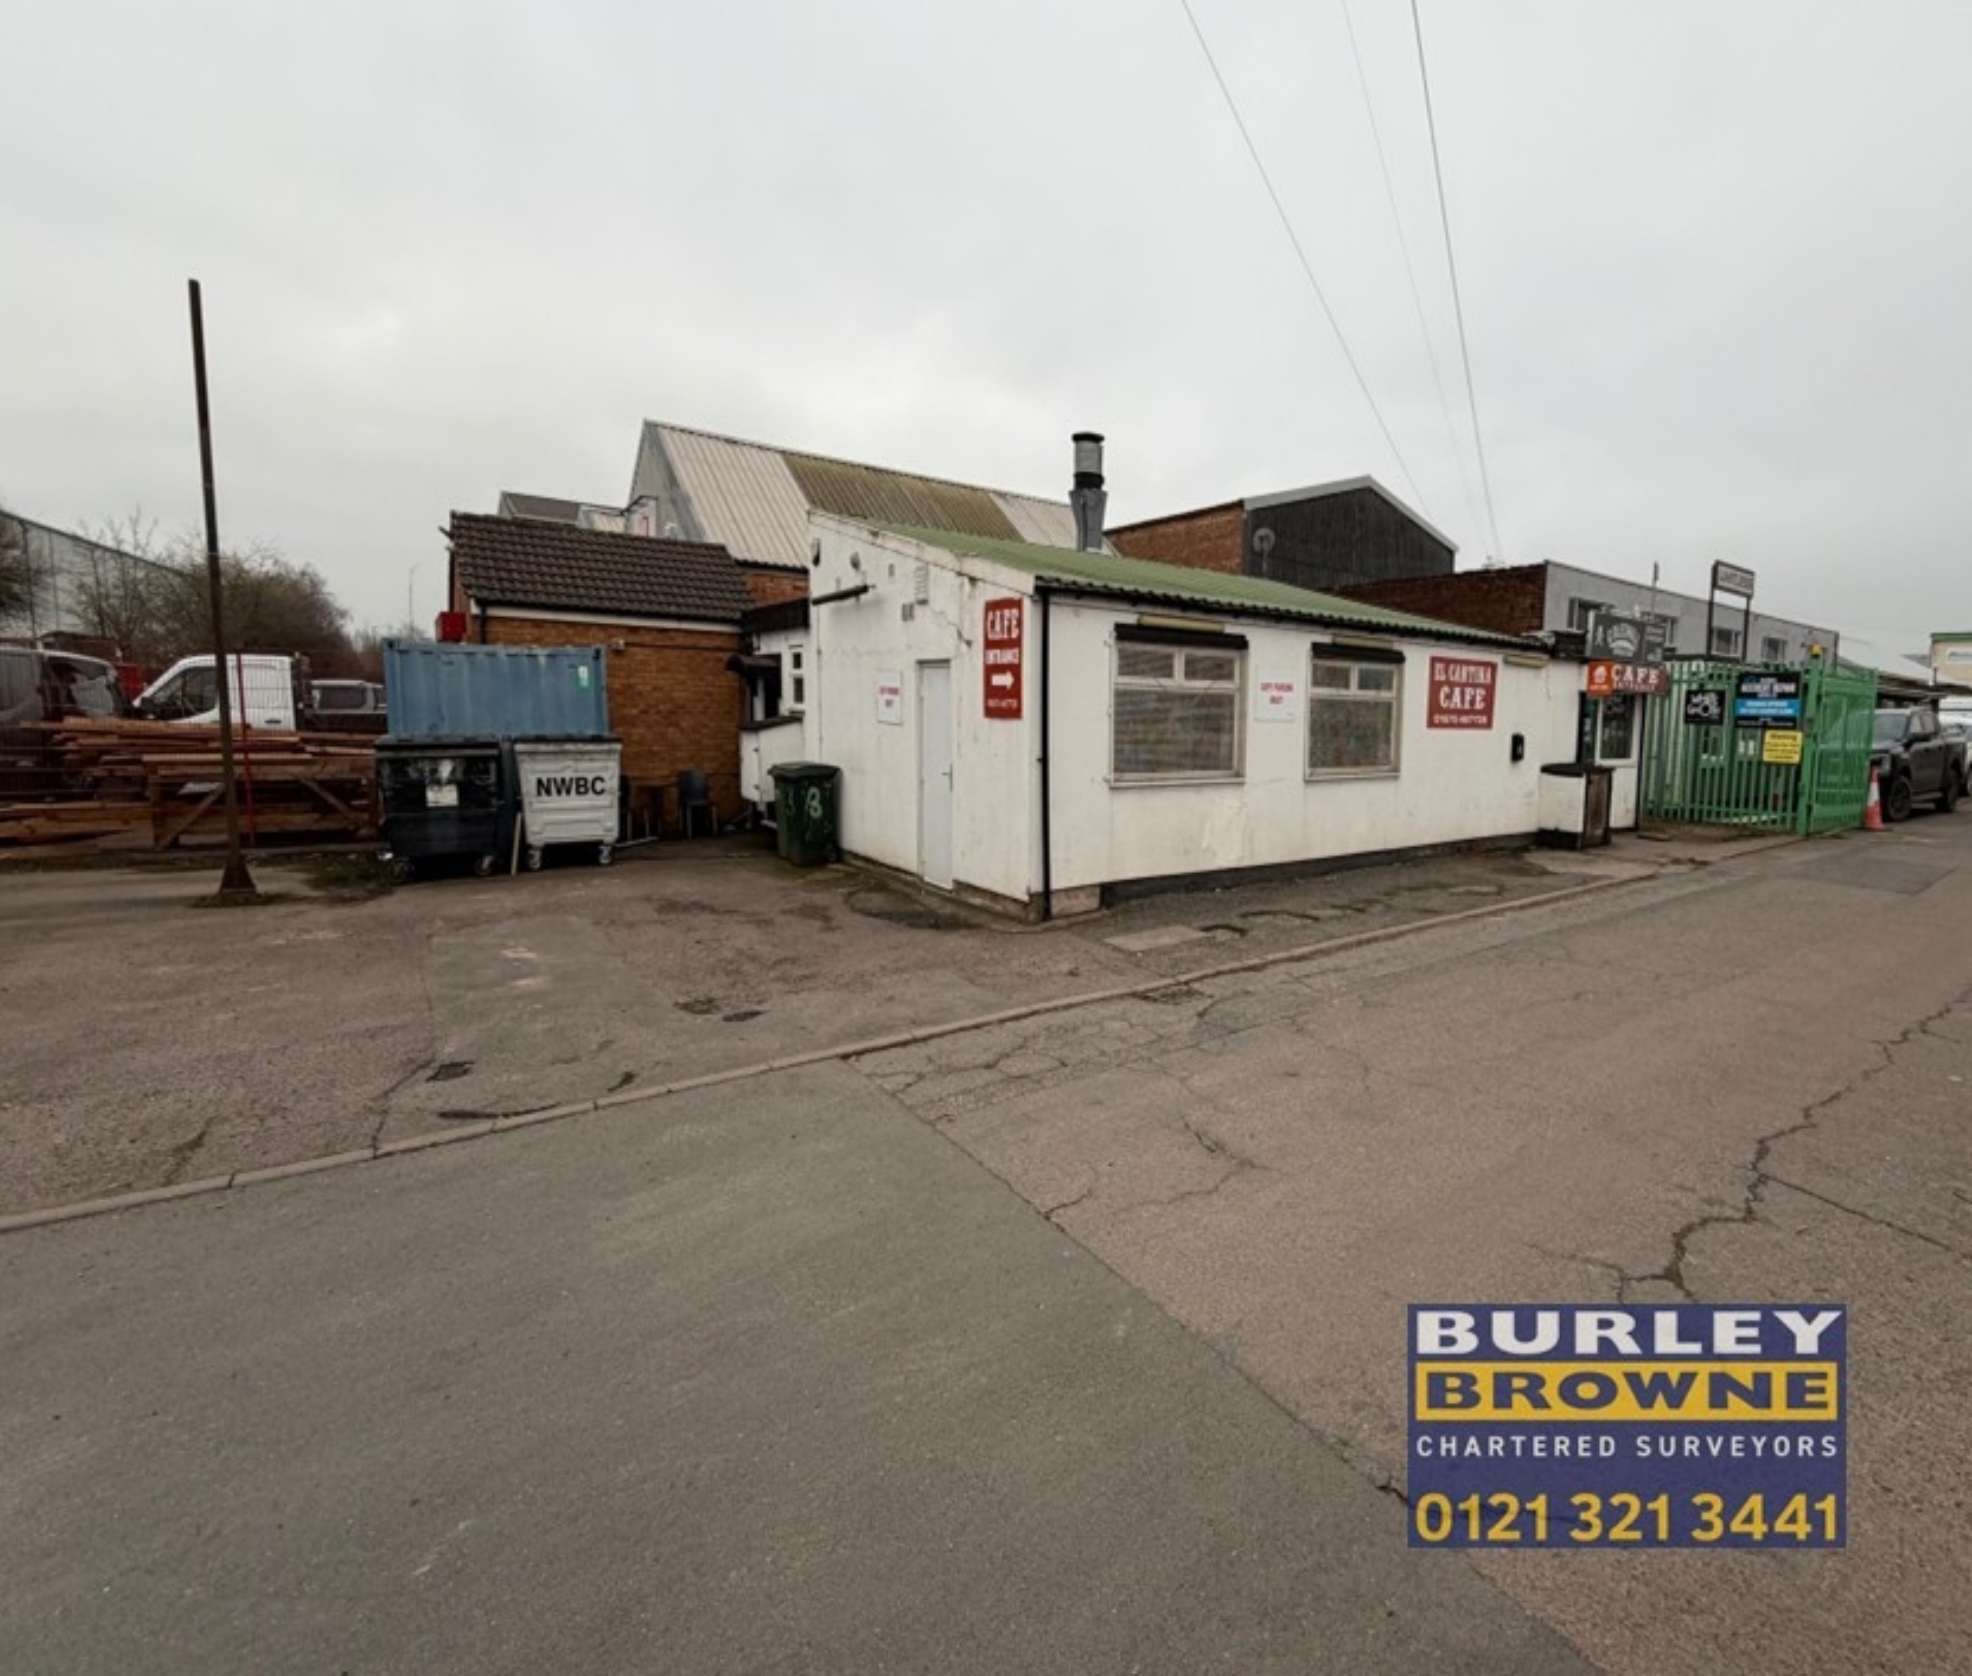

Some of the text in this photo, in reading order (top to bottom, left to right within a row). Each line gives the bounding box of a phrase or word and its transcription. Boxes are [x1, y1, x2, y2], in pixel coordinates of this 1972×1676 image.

[987, 608, 1019, 639] CAFE
[1611, 664, 1659, 684] CAFE
[1440, 685, 1486, 710] CAFE
[535, 776, 606, 797] NWBC
